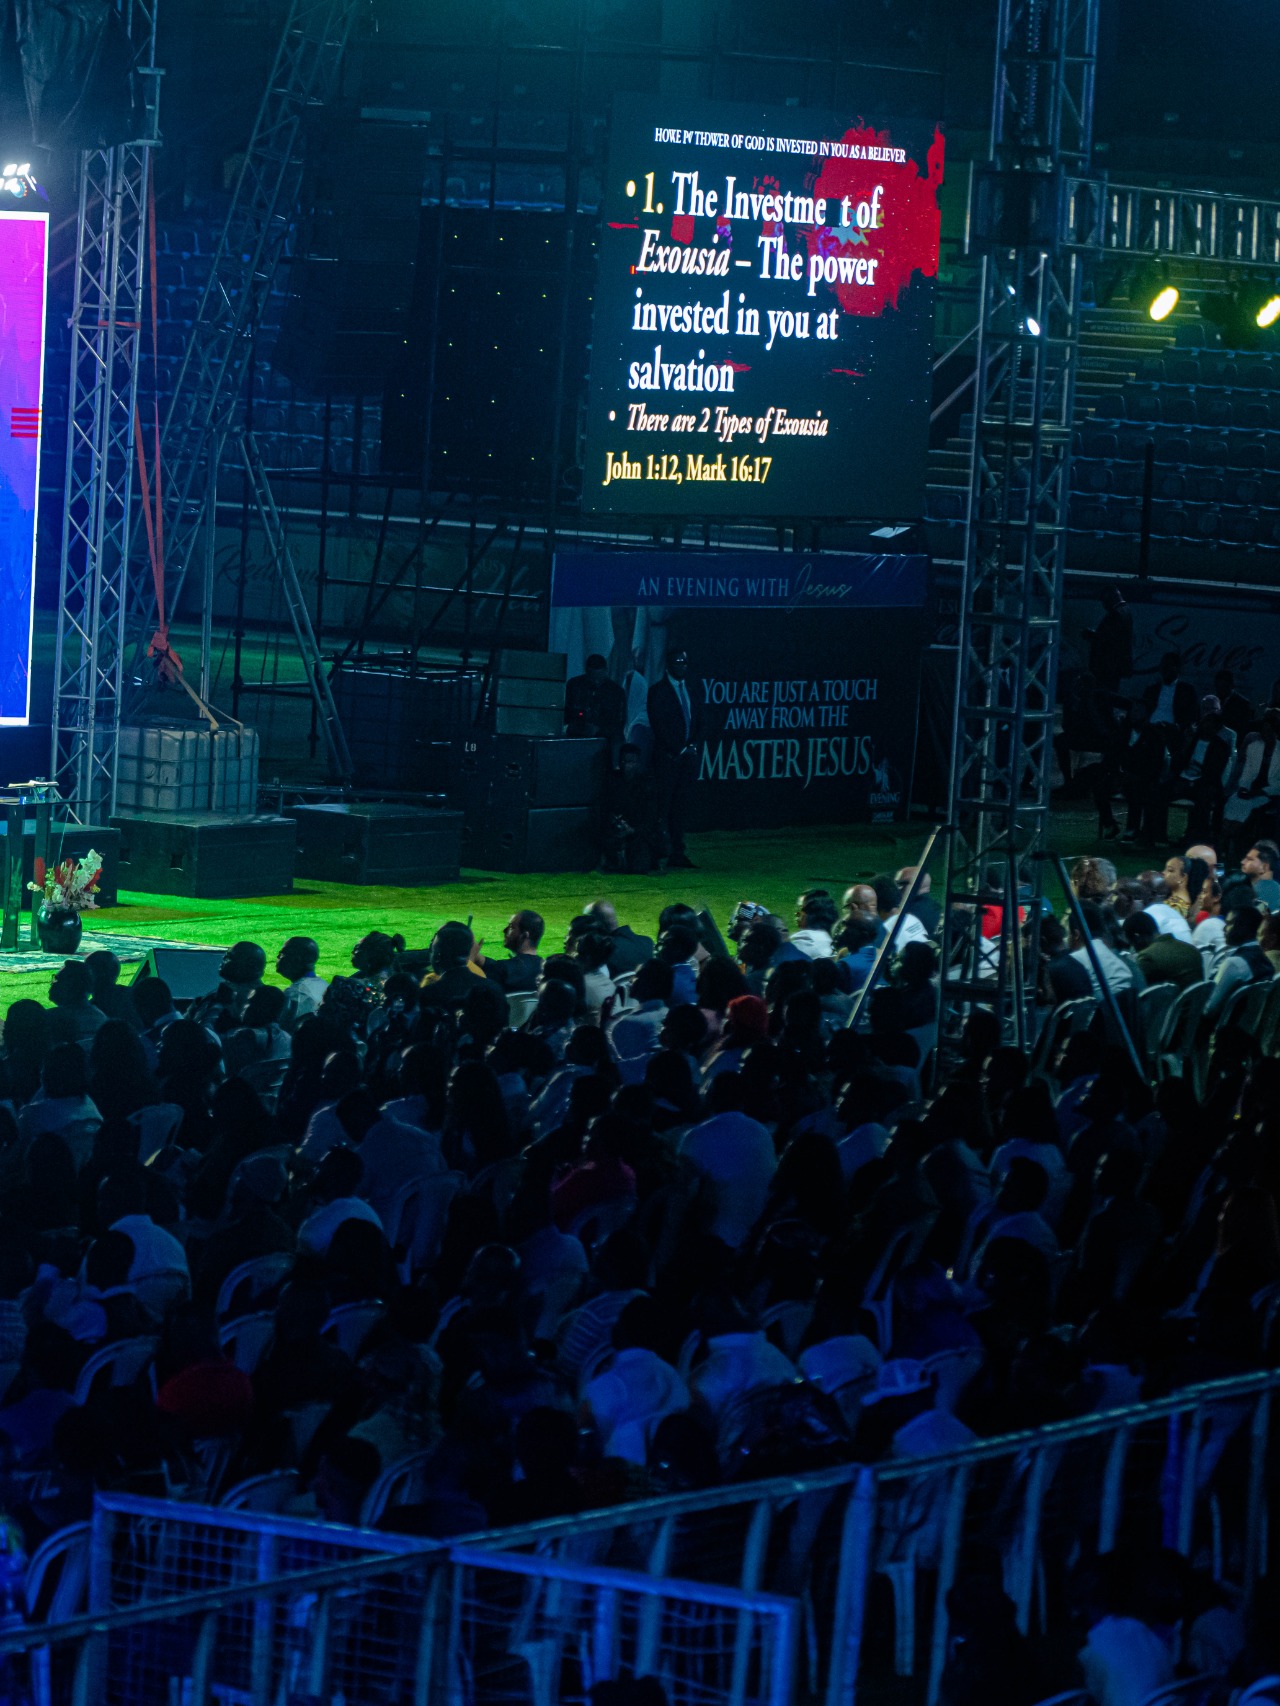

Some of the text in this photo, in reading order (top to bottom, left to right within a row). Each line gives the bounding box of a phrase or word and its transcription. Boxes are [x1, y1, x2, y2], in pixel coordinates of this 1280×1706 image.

[732, 134, 744, 148] OF
[745, 135, 765, 150] GOD
[766, 137, 775, 151] IS
[776, 138, 818, 155] INVESTED
[819, 142, 830, 156] IN
[830, 142, 848, 158] YOU
[849, 145, 860, 159] AS
[860, 146, 867, 160] A
[868, 146, 906, 163] BELIEVER
[642, 170, 884, 229] 1. The Investmet of
[636, 229, 730, 275] Exousia
[758, 236, 803, 281] The
[809, 256, 878, 297] power
[632, 287, 839, 351] invested in you at
[628, 345, 734, 393] salvation
[626, 403, 828, 443] There are 2 Types of Exousia
[603, 452, 772, 486] John 1:12, Mark 16:17
[638, 562, 852, 614] AN EVENING WITH Jesus
[702, 678, 878, 706] YOU ARE JUST A TOUCH
[724, 706, 849, 730] AWAY FROM THE
[697, 736, 872, 789] MASTER JESUS
